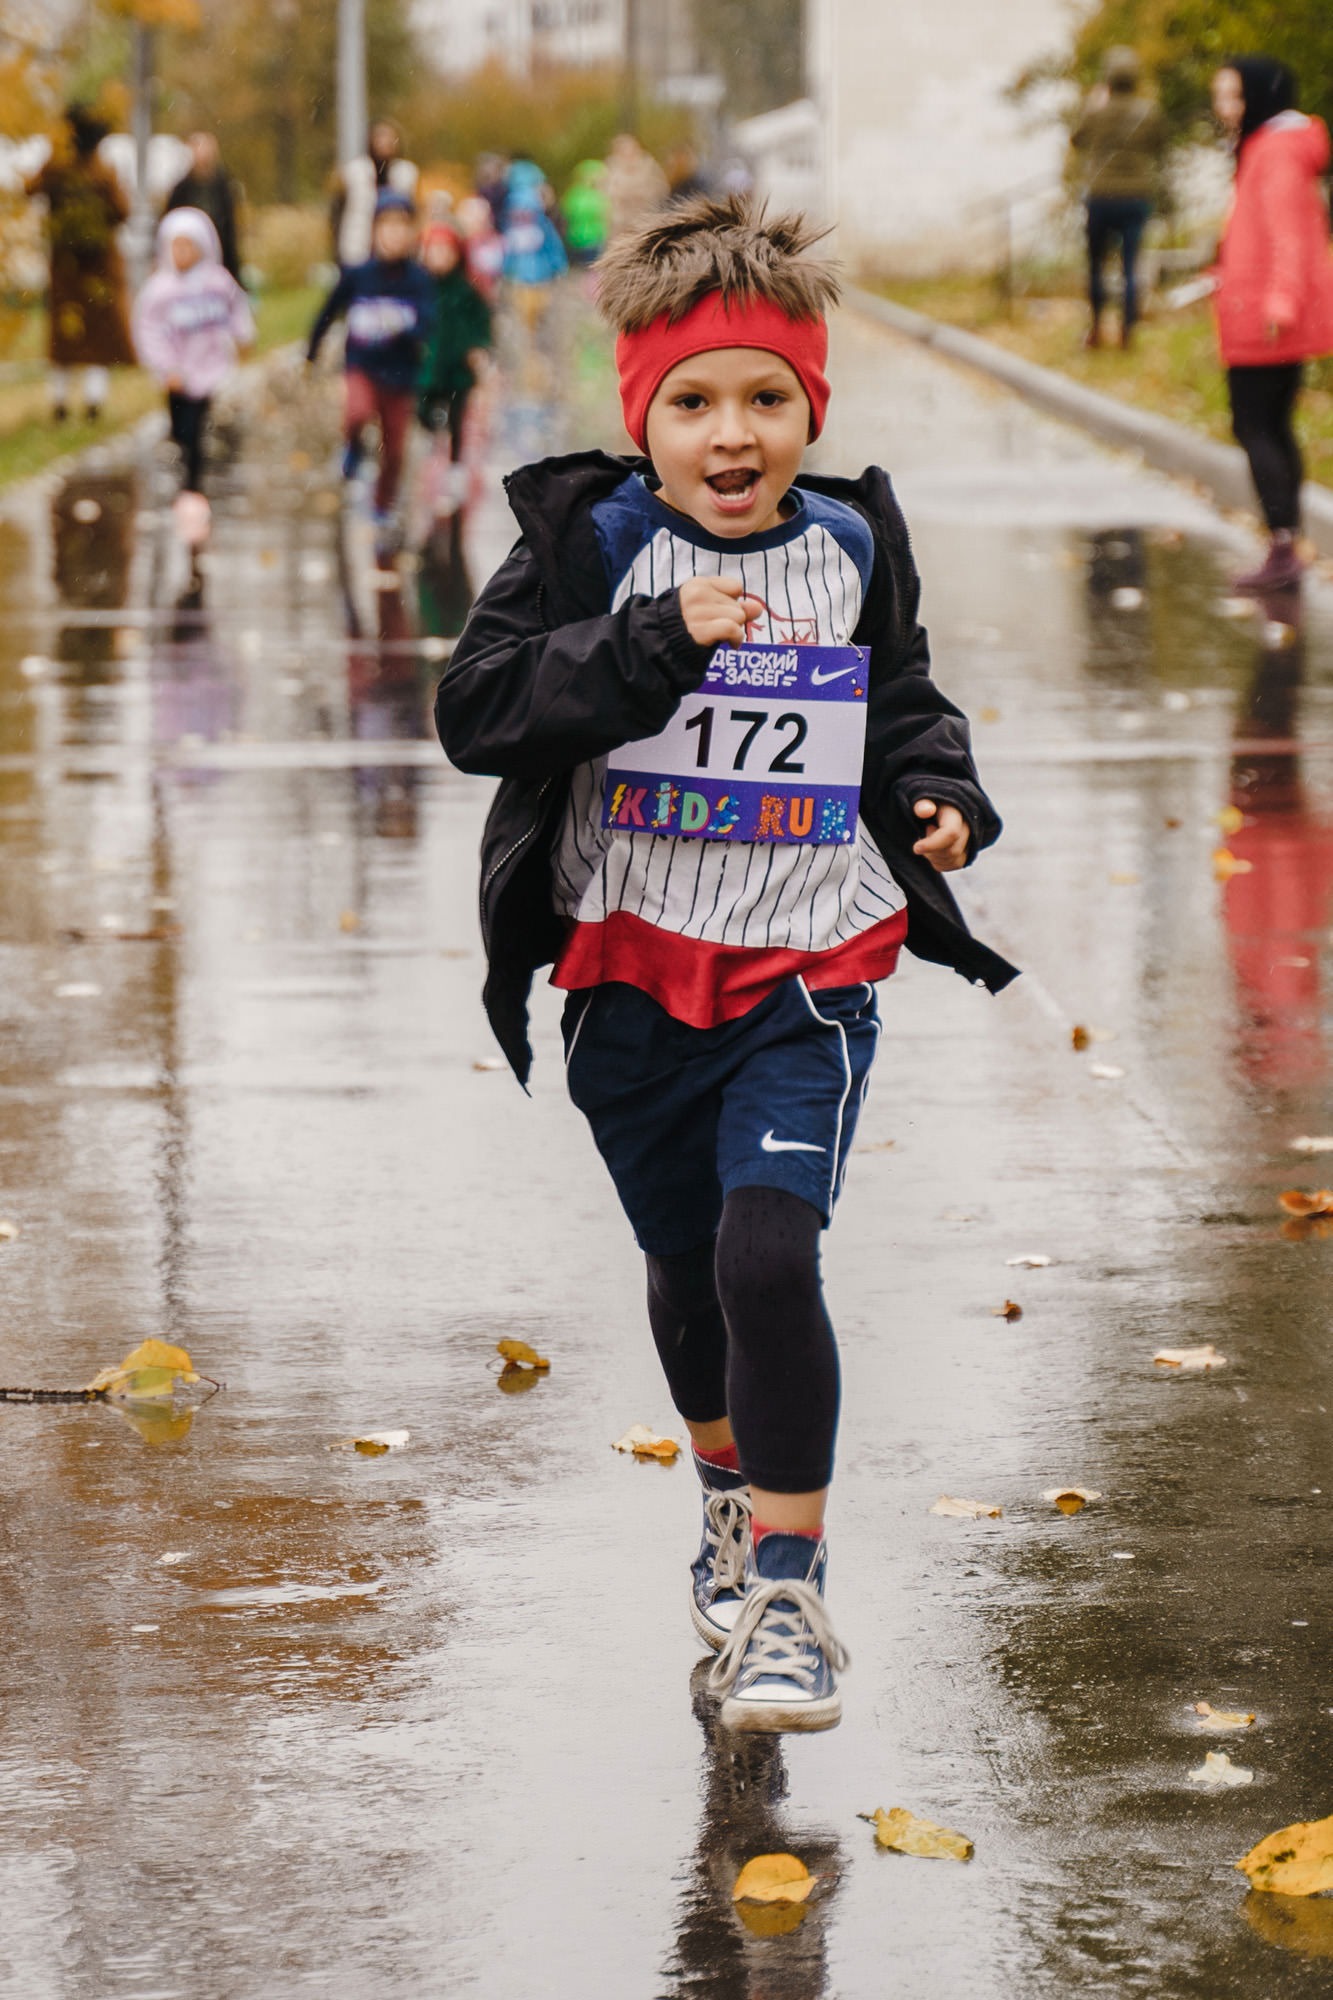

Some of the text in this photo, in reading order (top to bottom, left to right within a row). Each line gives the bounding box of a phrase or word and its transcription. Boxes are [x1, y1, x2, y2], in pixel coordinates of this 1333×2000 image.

[709, 649, 799, 672] ДЕТСКИЙ
[724, 668, 785, 687] ЗАБЕГ
[685, 706, 808, 774] 172
[613, 782, 850, 841] KIDS RUN
